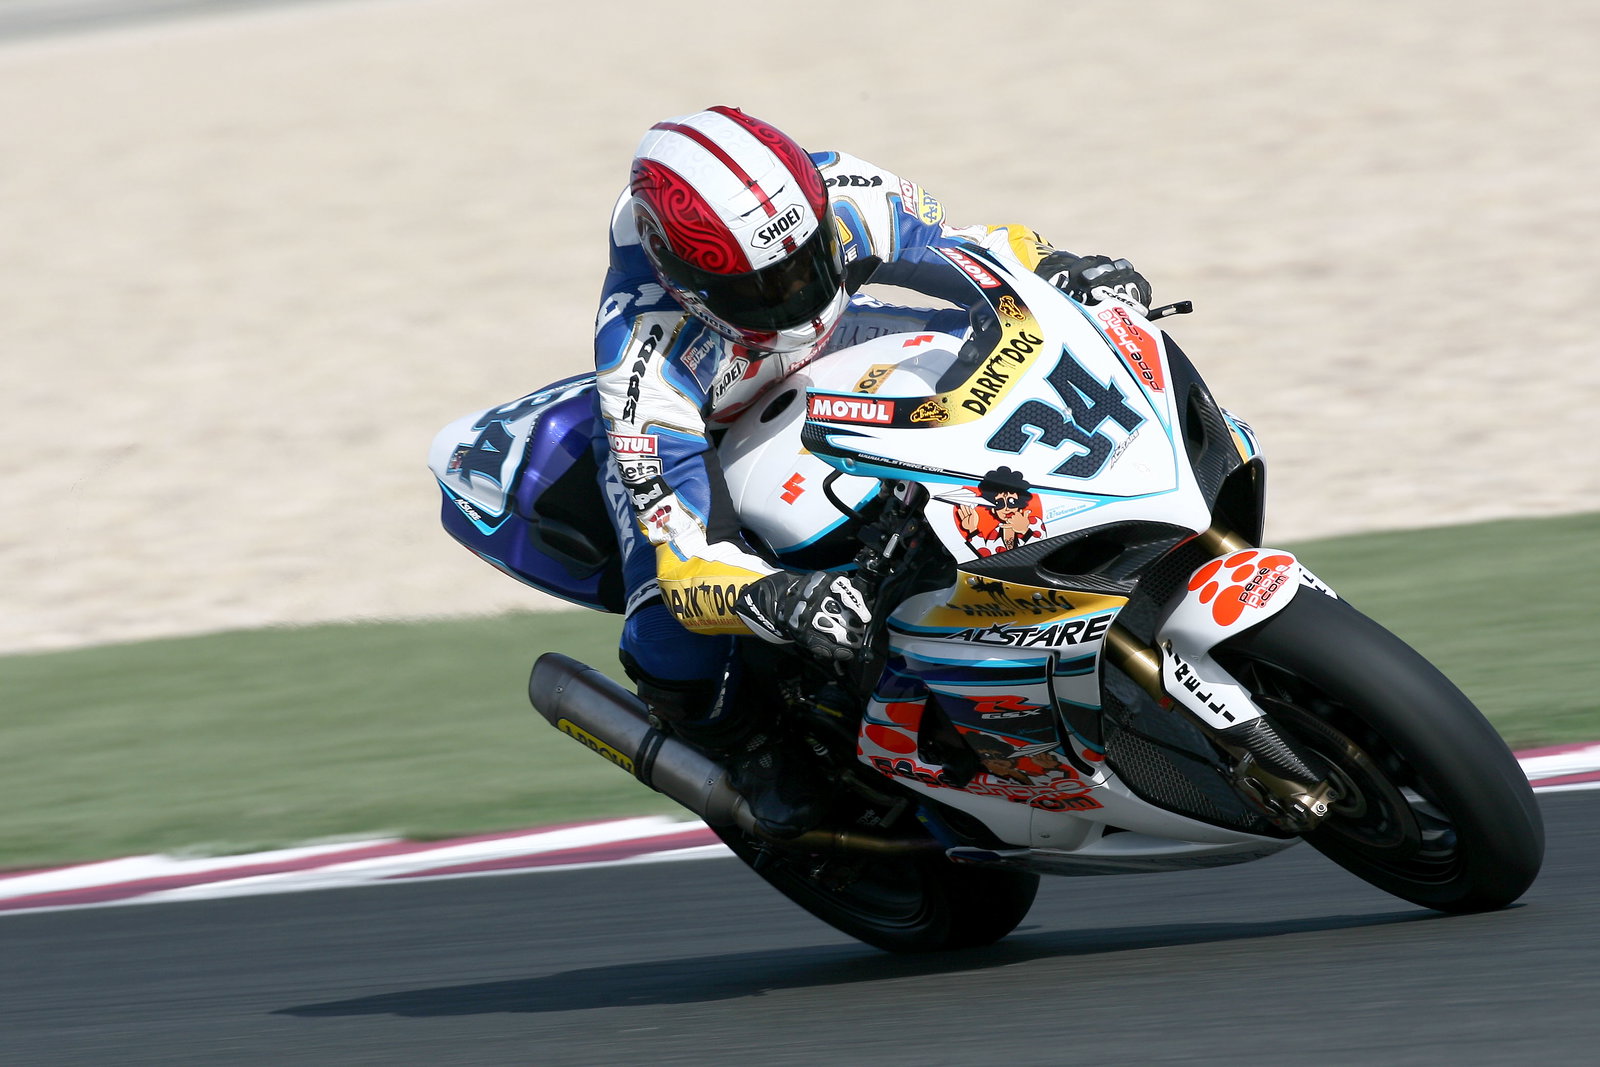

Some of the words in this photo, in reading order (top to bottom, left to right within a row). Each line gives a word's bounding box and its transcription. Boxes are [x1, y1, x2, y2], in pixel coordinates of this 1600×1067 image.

[758, 207, 801, 245] SHOEI
[939, 248, 995, 287] MOTUL
[715, 362, 743, 399] SHOEI
[962, 367, 1008, 416] DARK
[1002, 330, 1044, 364] DOG
[812, 399, 890, 421] MOTUL
[985, 343, 1148, 480] 34
[617, 460, 658, 480] Beta
[946, 614, 1113, 648] ALSTARE
